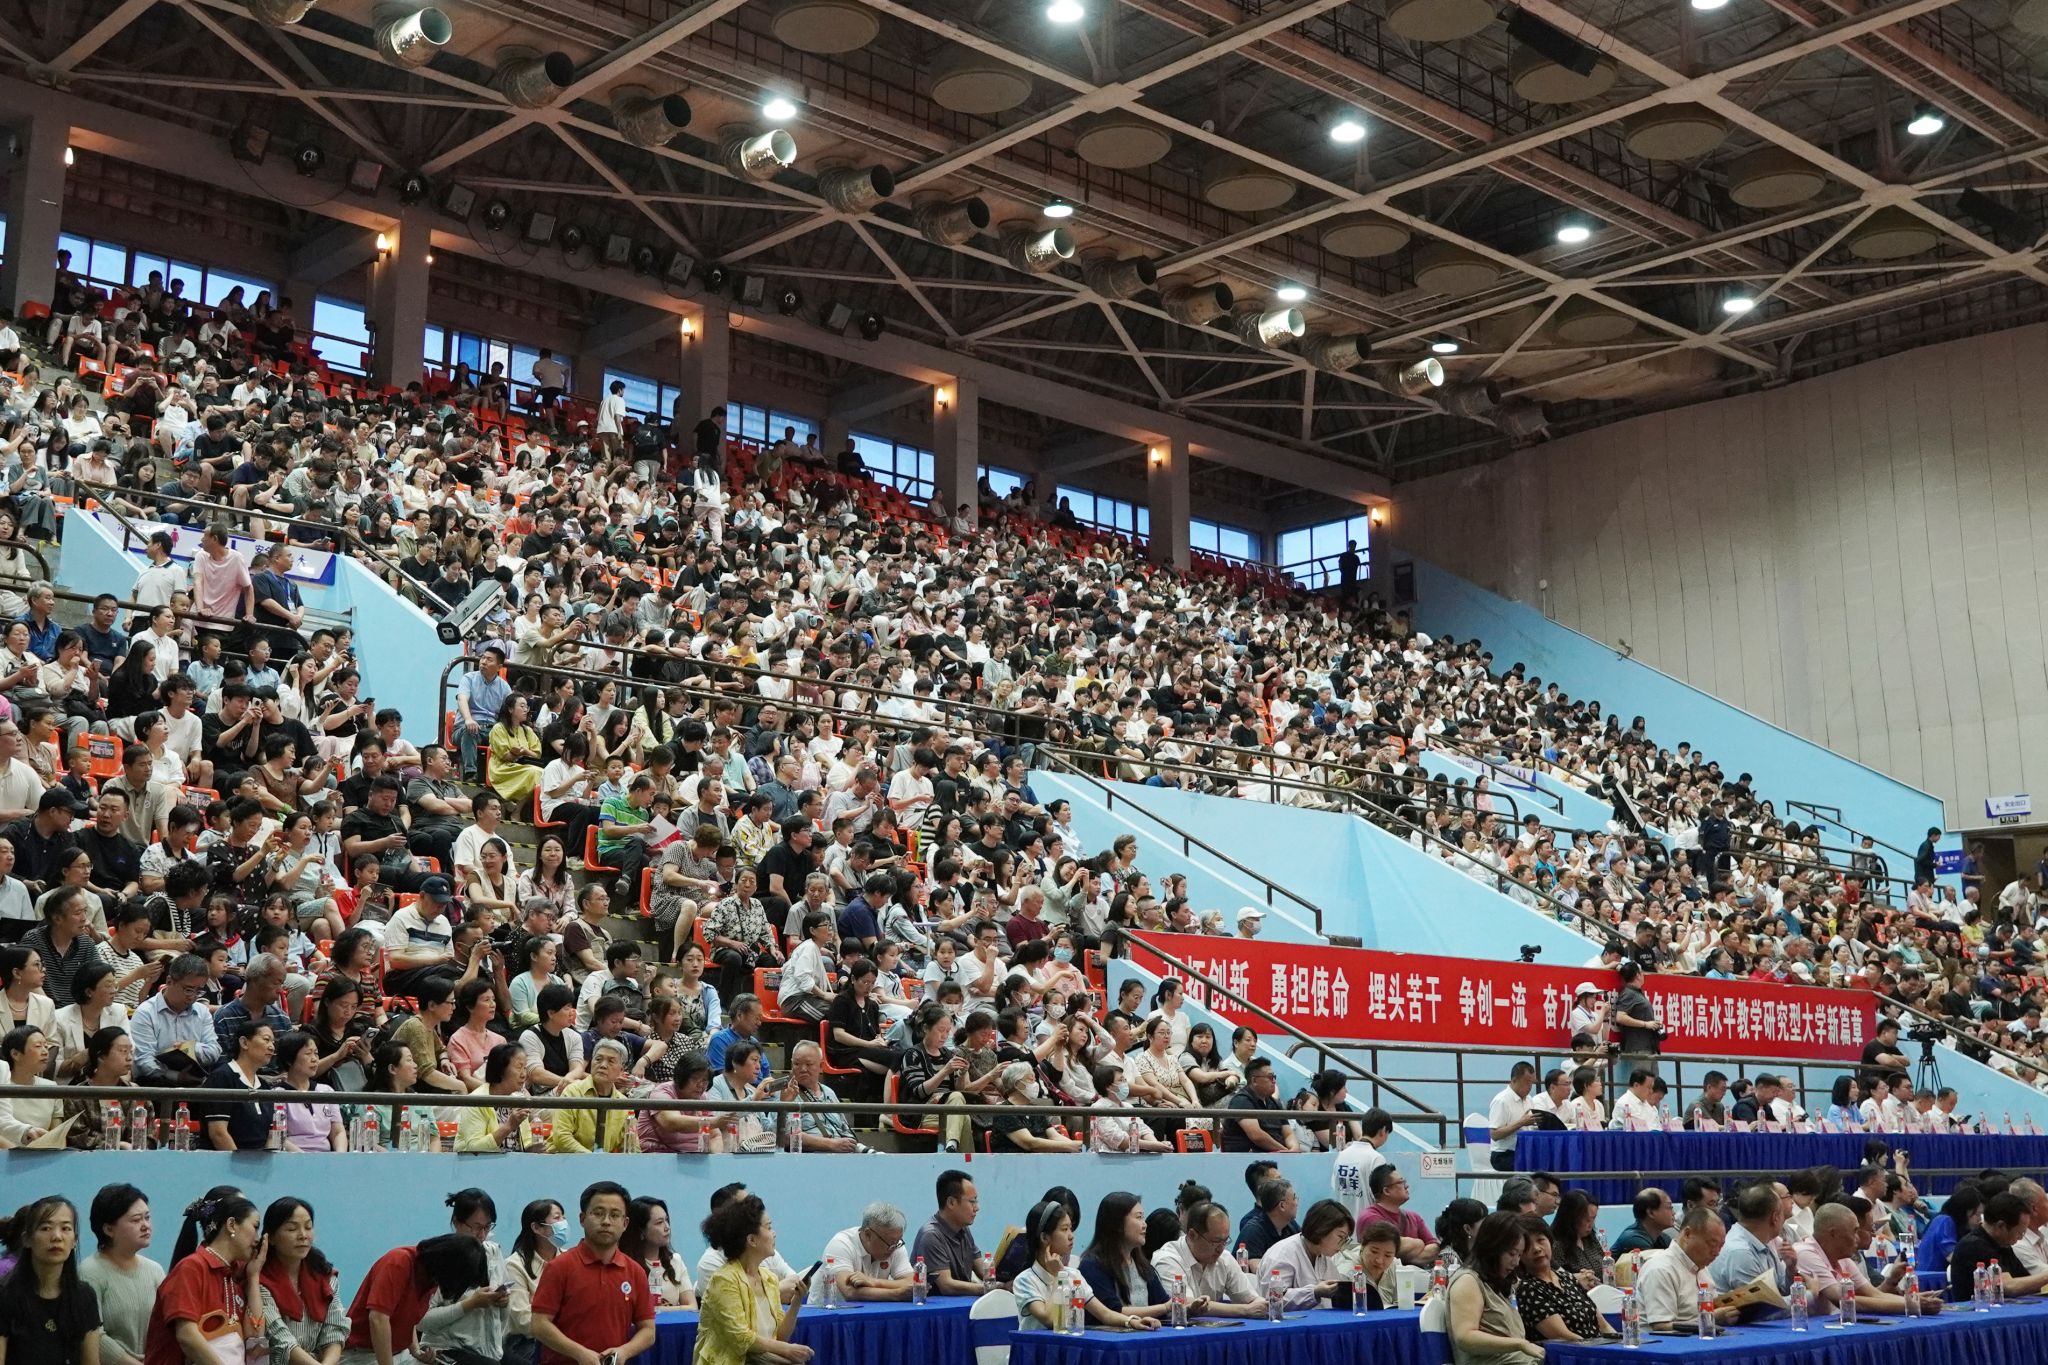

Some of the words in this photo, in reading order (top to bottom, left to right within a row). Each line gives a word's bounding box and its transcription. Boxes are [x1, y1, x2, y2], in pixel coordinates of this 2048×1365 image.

[1271, 963, 1350, 1020] 勇担使命
[1368, 971, 1442, 1024] 埋头苦干
[1458, 977, 1528, 1029] 争创一流
[1338, 1164, 1359, 1178] 石大
